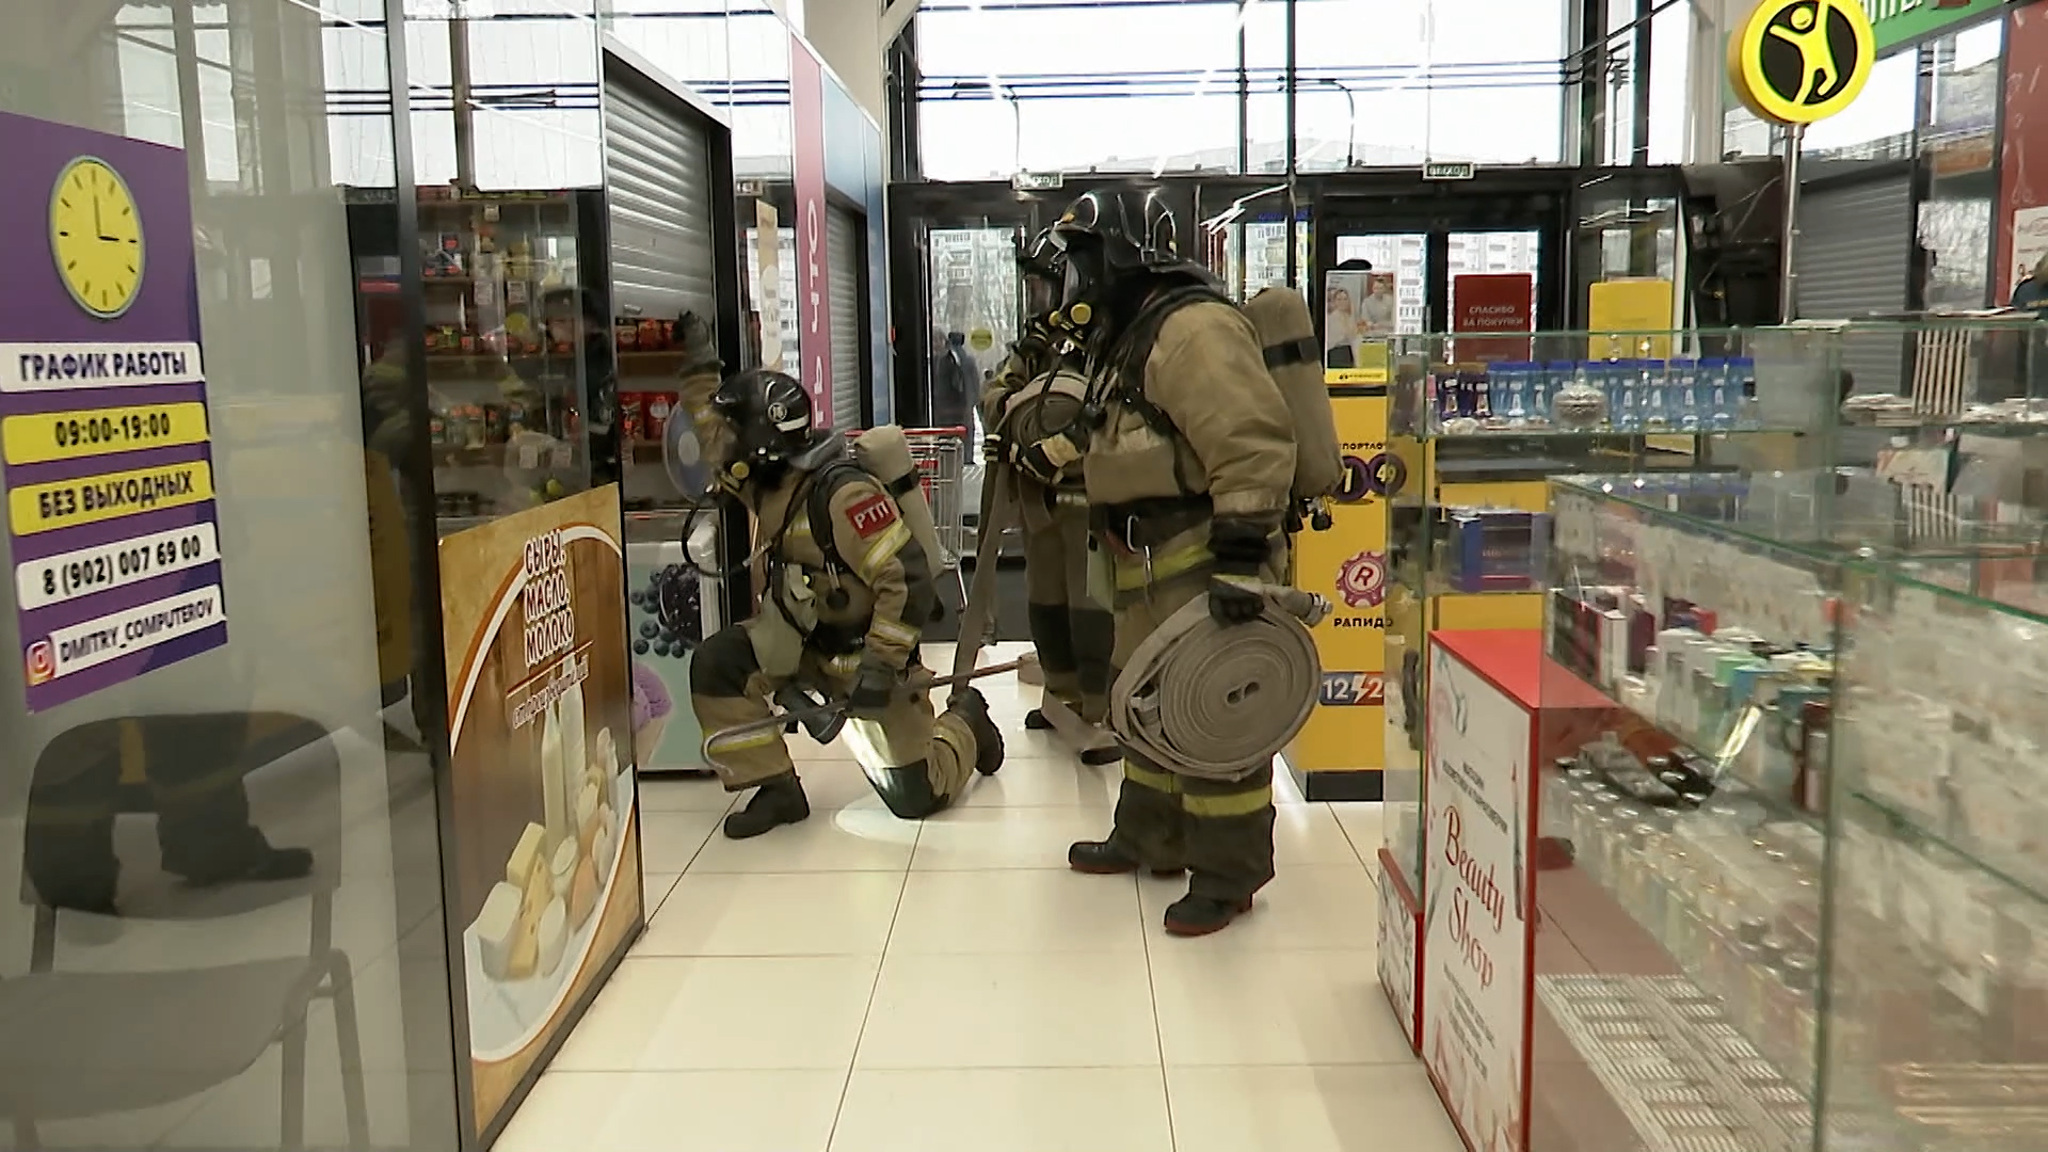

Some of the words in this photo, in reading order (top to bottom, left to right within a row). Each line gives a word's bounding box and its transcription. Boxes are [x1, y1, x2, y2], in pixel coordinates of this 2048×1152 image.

[807, 198, 820, 333] ЧТО
[1468, 305, 1515, 315] СПАСИБО
[1477, 317, 1524, 327] ПОКУПКИ
[20, 353, 110, 381] ГРАФИК
[114, 351, 187, 377] РАБОТЫ
[814, 356, 824, 428] ТЬ
[55, 412, 170, 448] 09:00-19:00
[1340, 443, 1385, 451] ПОРТЛО
[38, 488, 78, 519] БЕЗ
[82, 470, 194, 510] ВЫХОДНЫХ
[853, 501, 890, 530] РТП
[43, 567, 56, 596] 8
[62, 554, 113, 597] (902)
[119, 546, 151, 577] 007
[157, 540, 177, 566] 69
[182, 534, 201, 560] 00
[1353, 565, 1374, 587] R
[60, 598, 213, 662] DMITRY_COMPUTEROV
[526, 608, 574, 667] МОЛОКО
[1334, 617, 1393, 628] РАПИДО
[1322, 677, 1349, 700] 12
[1444, 805, 1505, 934] Beauty
[1449, 886, 1493, 992] Shop
